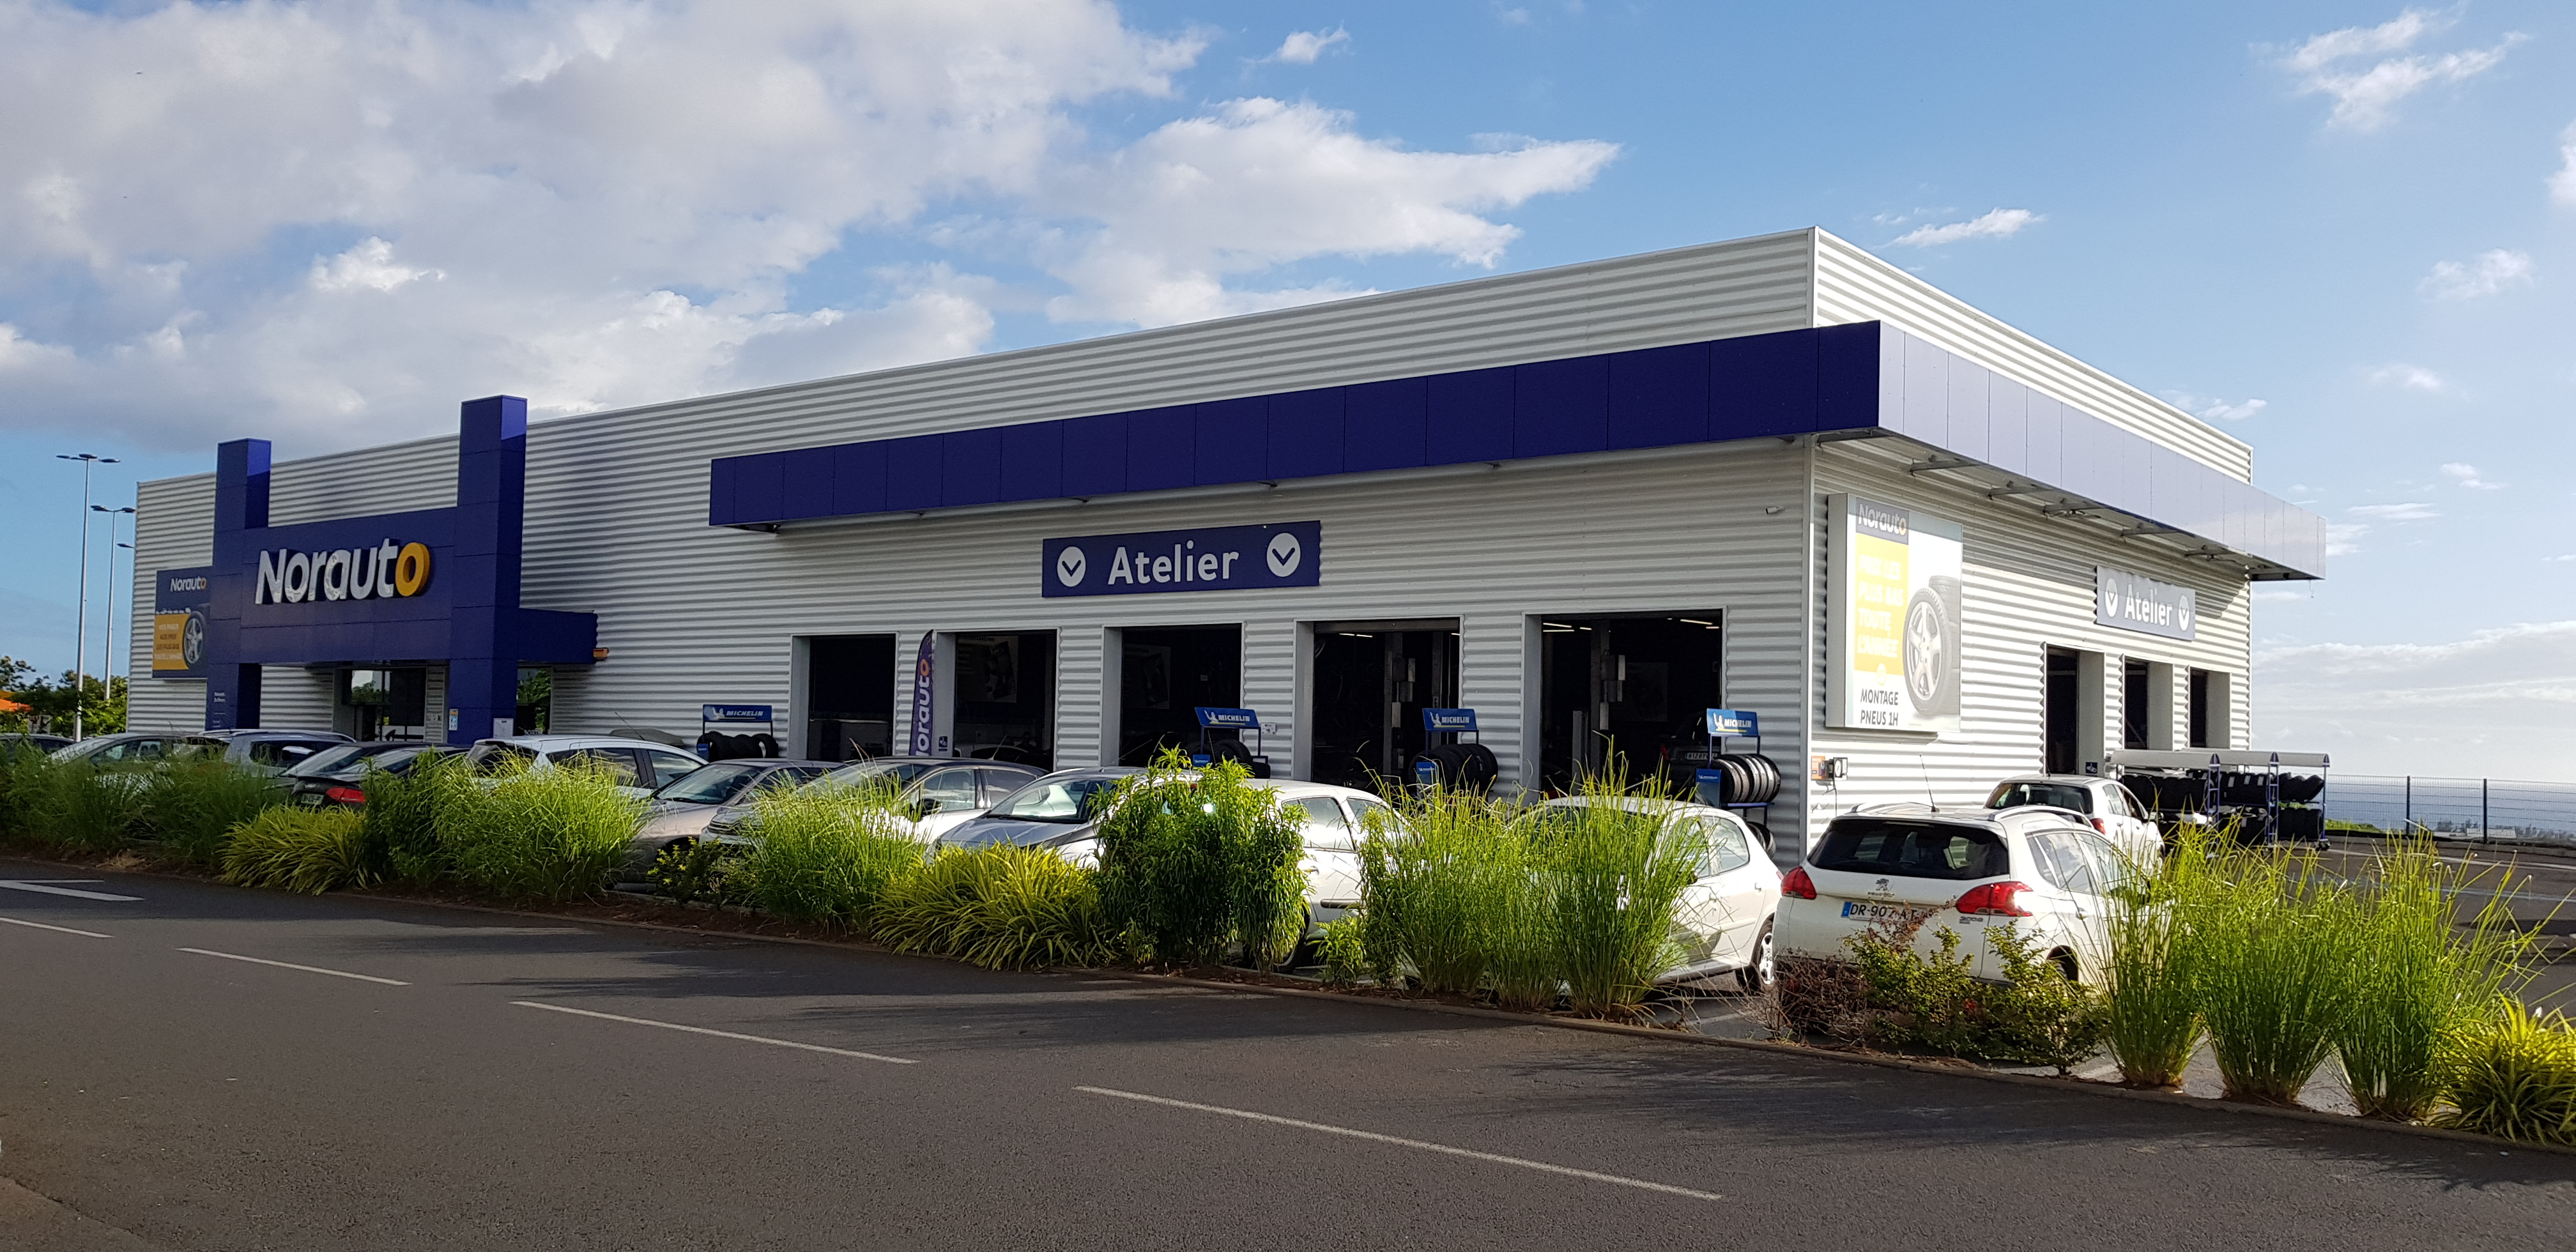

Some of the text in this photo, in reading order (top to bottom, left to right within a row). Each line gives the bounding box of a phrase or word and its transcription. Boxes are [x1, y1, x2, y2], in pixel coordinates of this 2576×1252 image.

[1859, 504, 1907, 535] Norauto
[255, 537, 431, 604] Norauto
[1107, 540, 1239, 585] Atelier
[1884, 560, 1901, 580] LES
[170, 576, 207, 592] Norauto
[1859, 581, 1883, 603] PLUS
[2124, 584, 2172, 626] Atelier
[1858, 607, 1892, 630] TOUTE
[1860, 688, 1899, 706] MONTAGE
[1724, 719, 1752, 728] MICHELIN
[1860, 709, 1898, 726] PNEUS 1H
